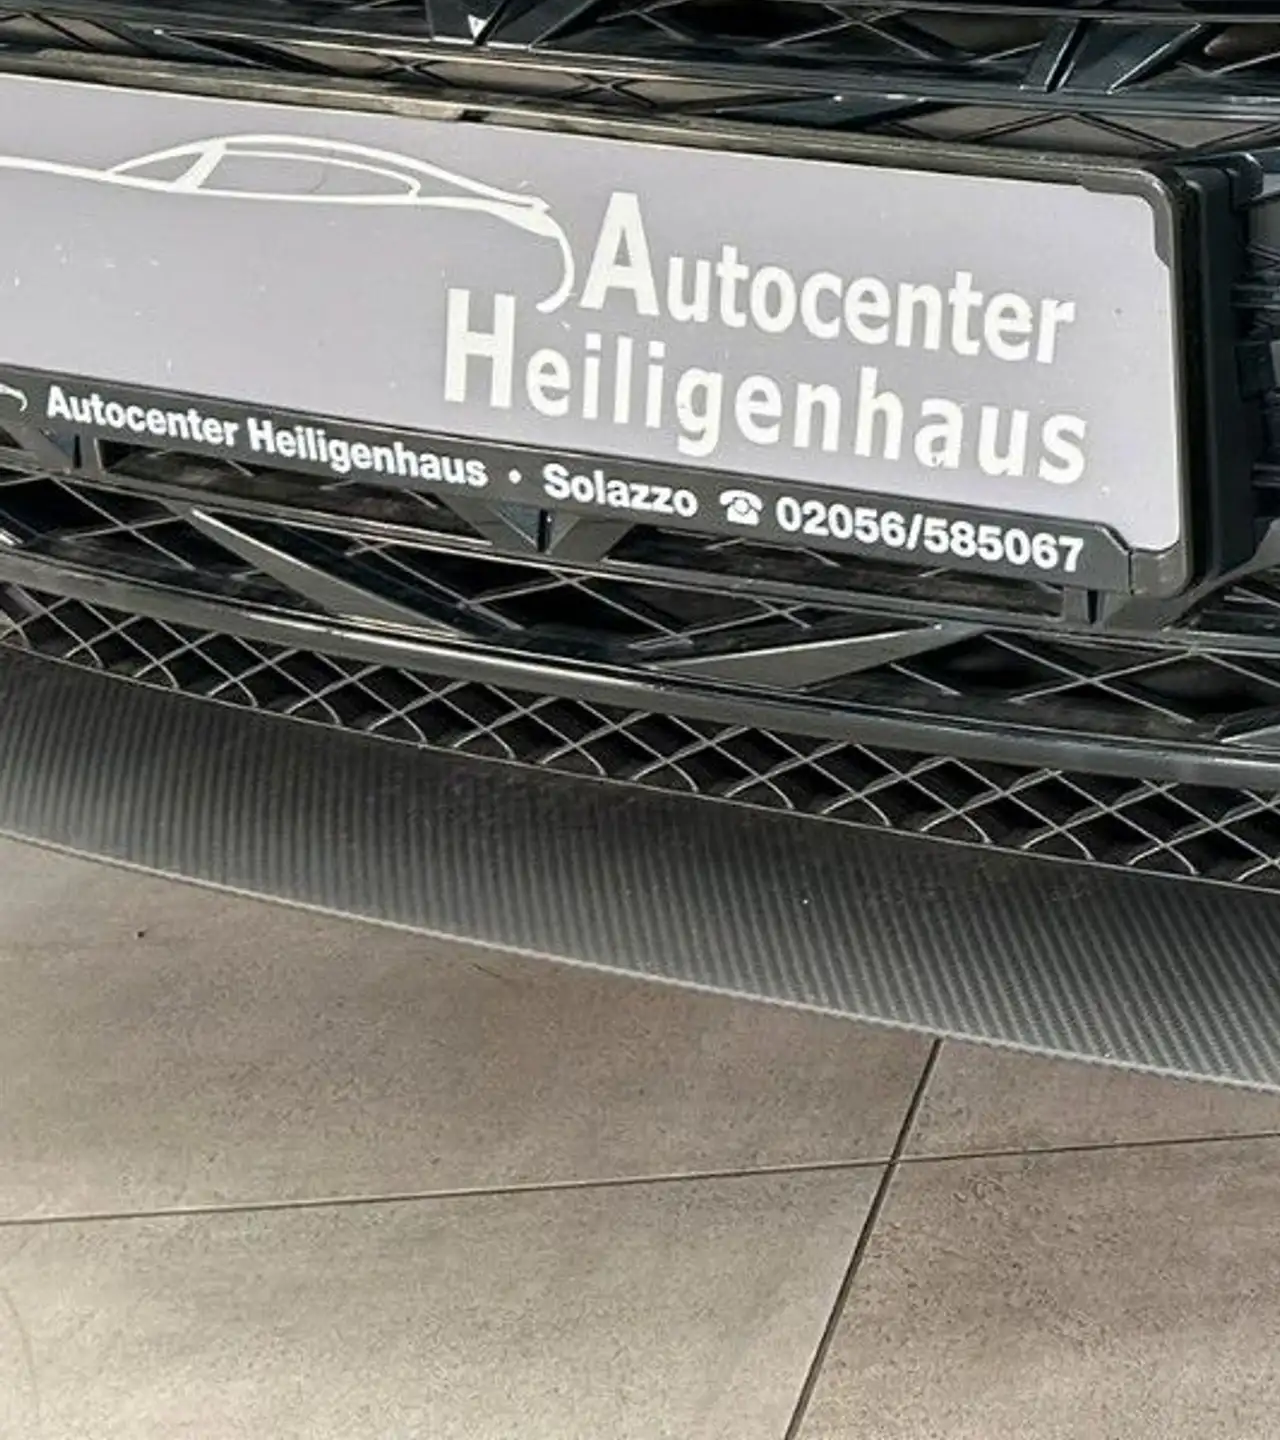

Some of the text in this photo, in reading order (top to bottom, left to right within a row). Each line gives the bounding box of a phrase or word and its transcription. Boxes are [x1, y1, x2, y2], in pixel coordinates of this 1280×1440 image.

[577, 190, 1076, 365] Autocenter
[46, 383, 1086, 574] Autocenter Heiligenhaus Solazzo 02056/585067
[442, 286, 1090, 486] Heiligenhaus
